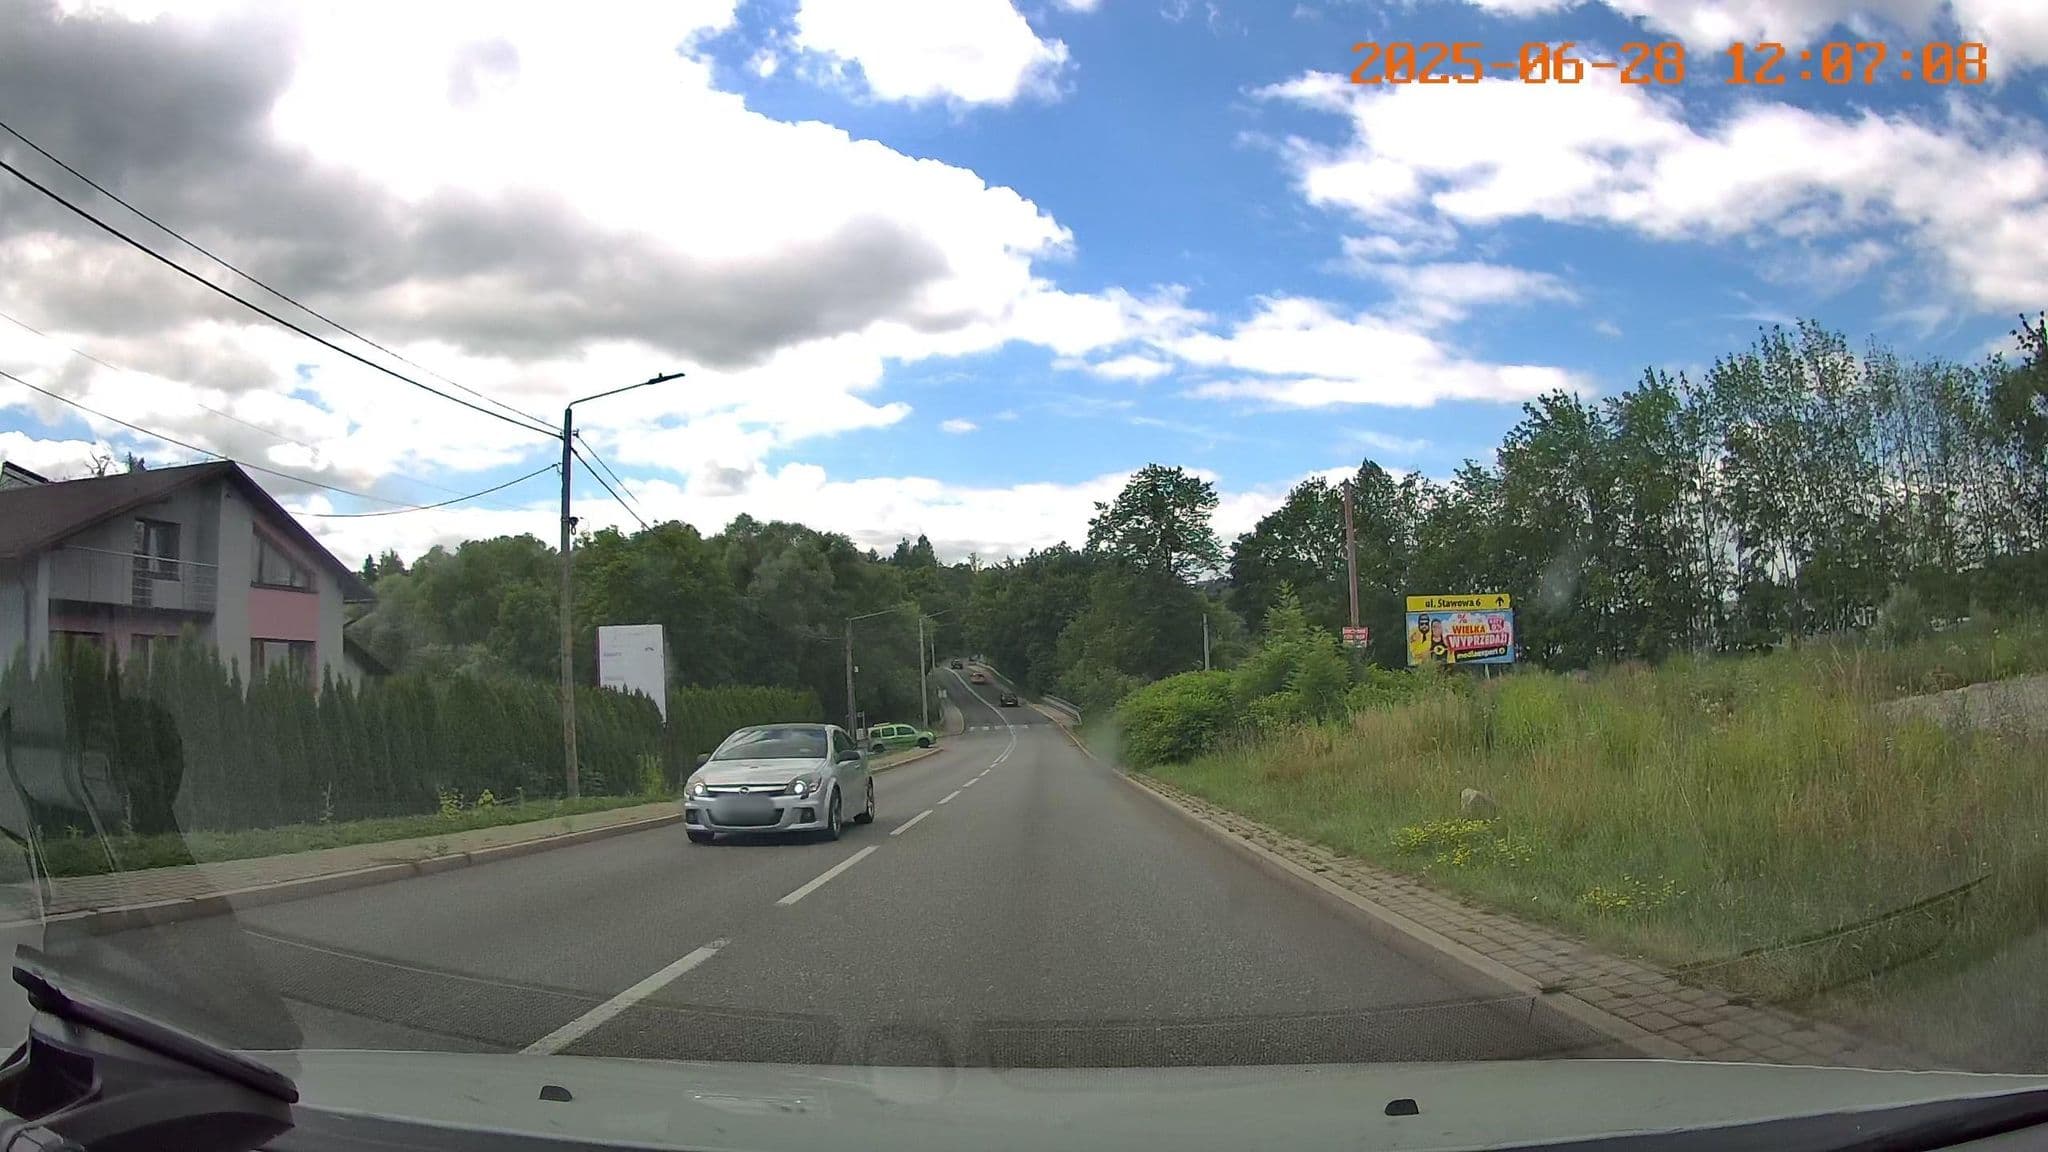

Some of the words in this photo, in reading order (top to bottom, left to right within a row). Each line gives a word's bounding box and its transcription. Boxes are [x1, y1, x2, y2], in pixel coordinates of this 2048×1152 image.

[1425, 600, 1436, 608] ul.
[1438, 599, 1474, 608] Stawowa
[1476, 599, 1482, 607] 6
[1452, 625, 1486, 634] WIELKA
